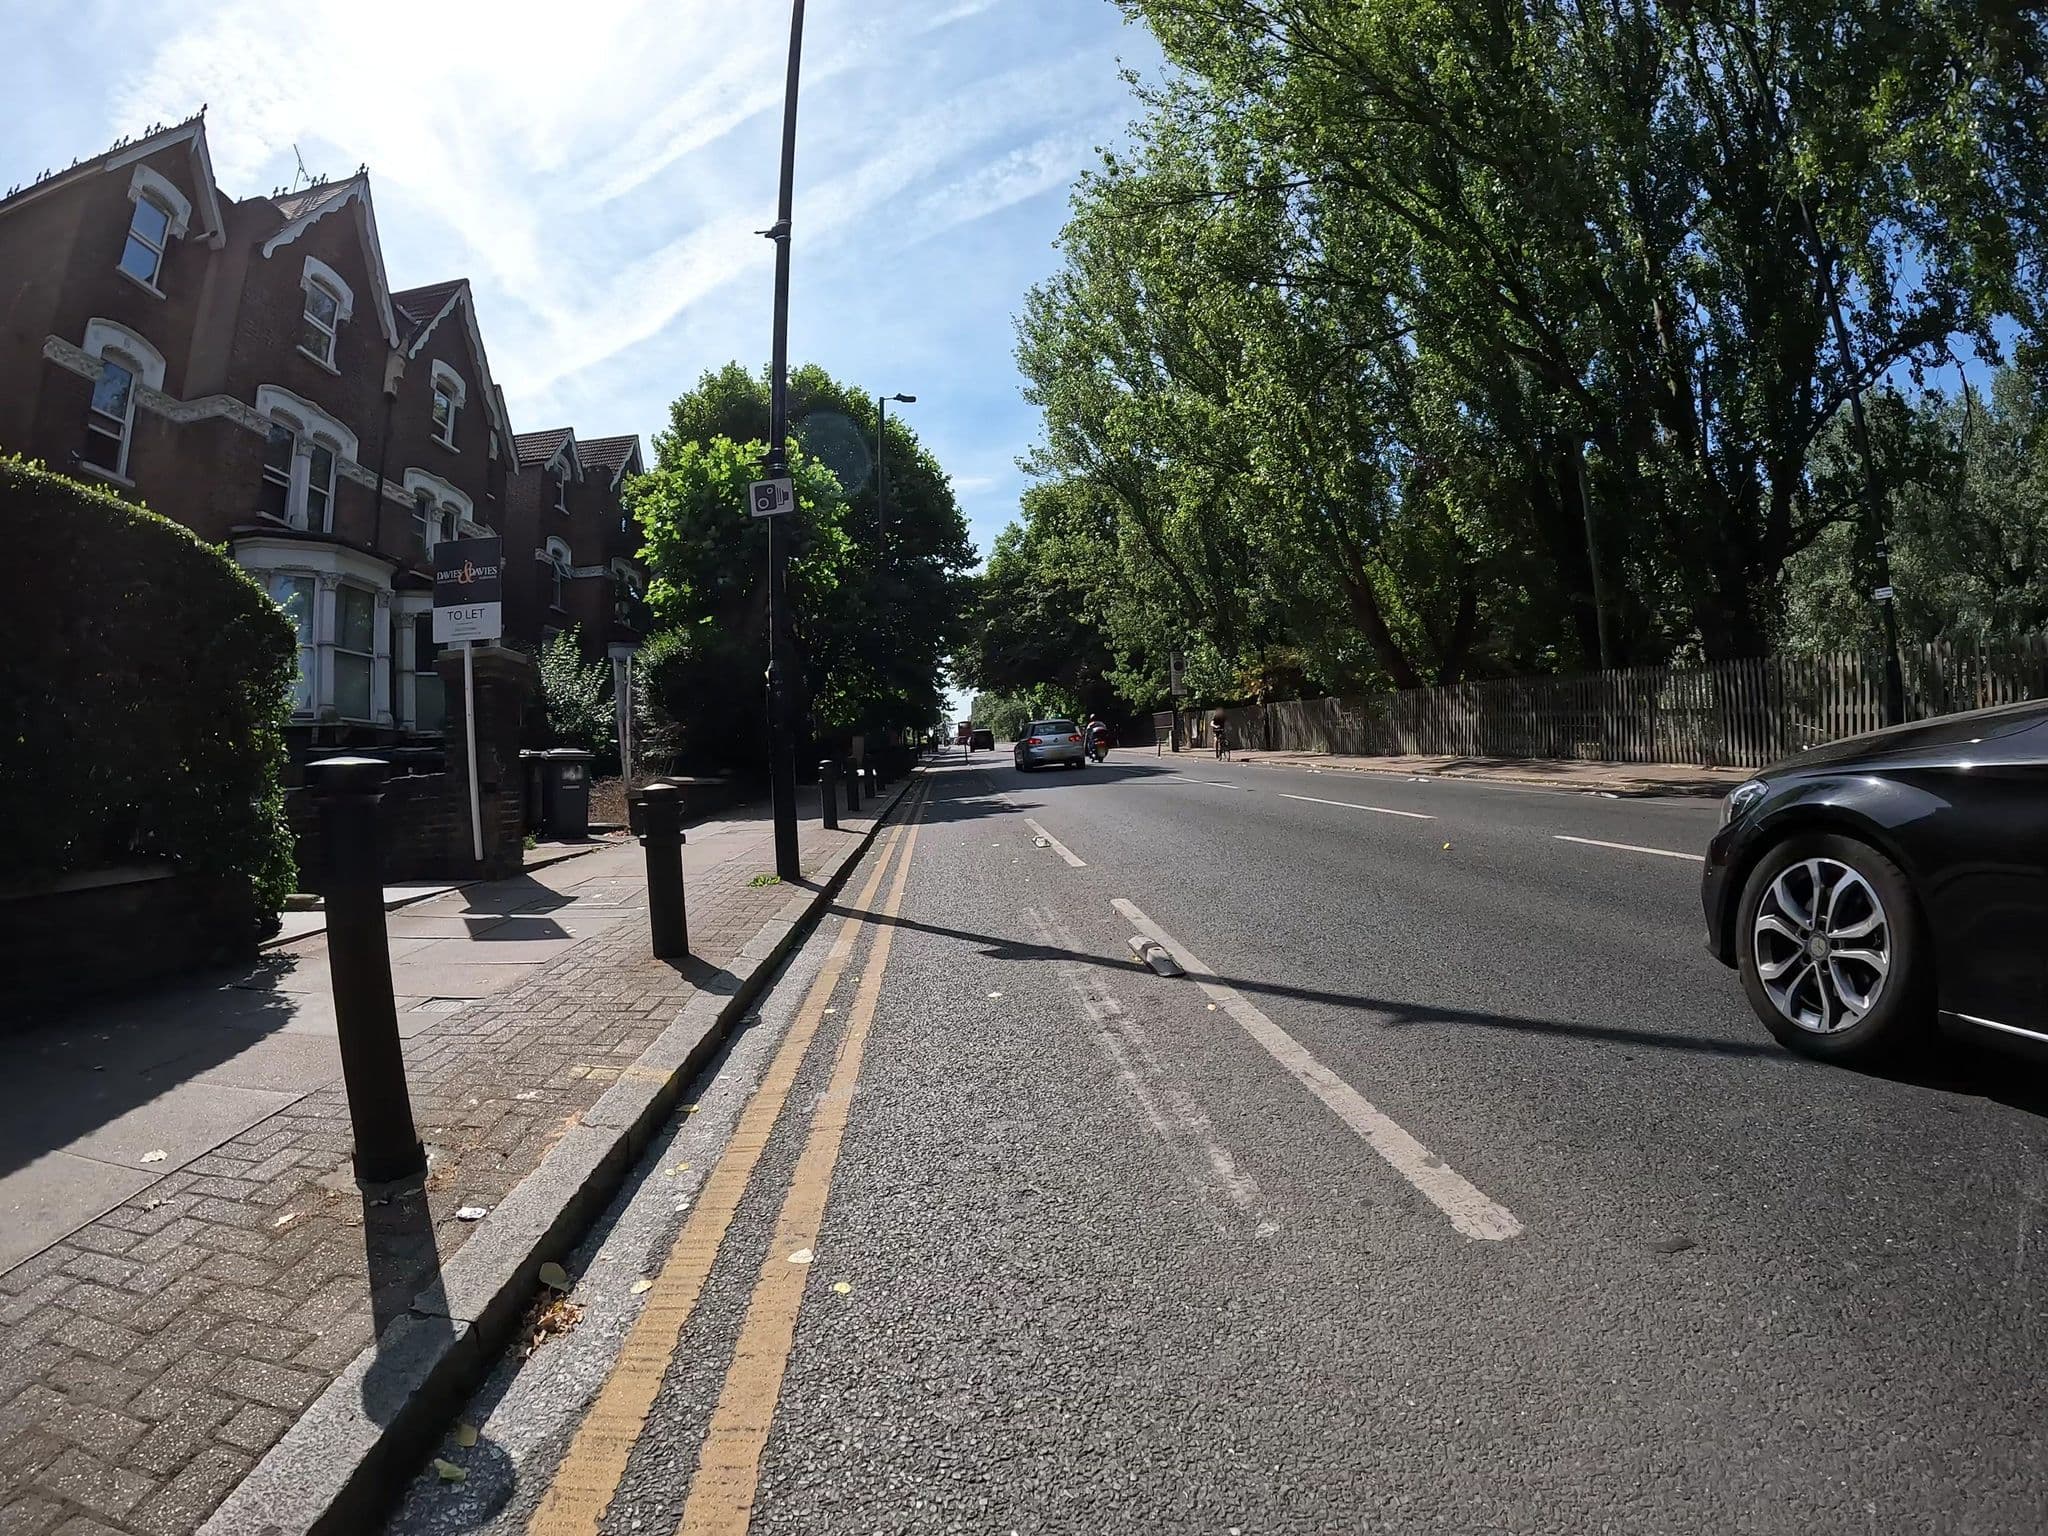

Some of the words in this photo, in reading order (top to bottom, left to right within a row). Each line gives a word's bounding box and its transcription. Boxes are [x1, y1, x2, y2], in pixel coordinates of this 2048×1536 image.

[436, 569, 462, 579] DAVIES
[458, 561, 475, 583] &
[470, 566, 497, 576] DAVIES
[447, 610, 462, 621] TO
[465, 608, 485, 619] LET
